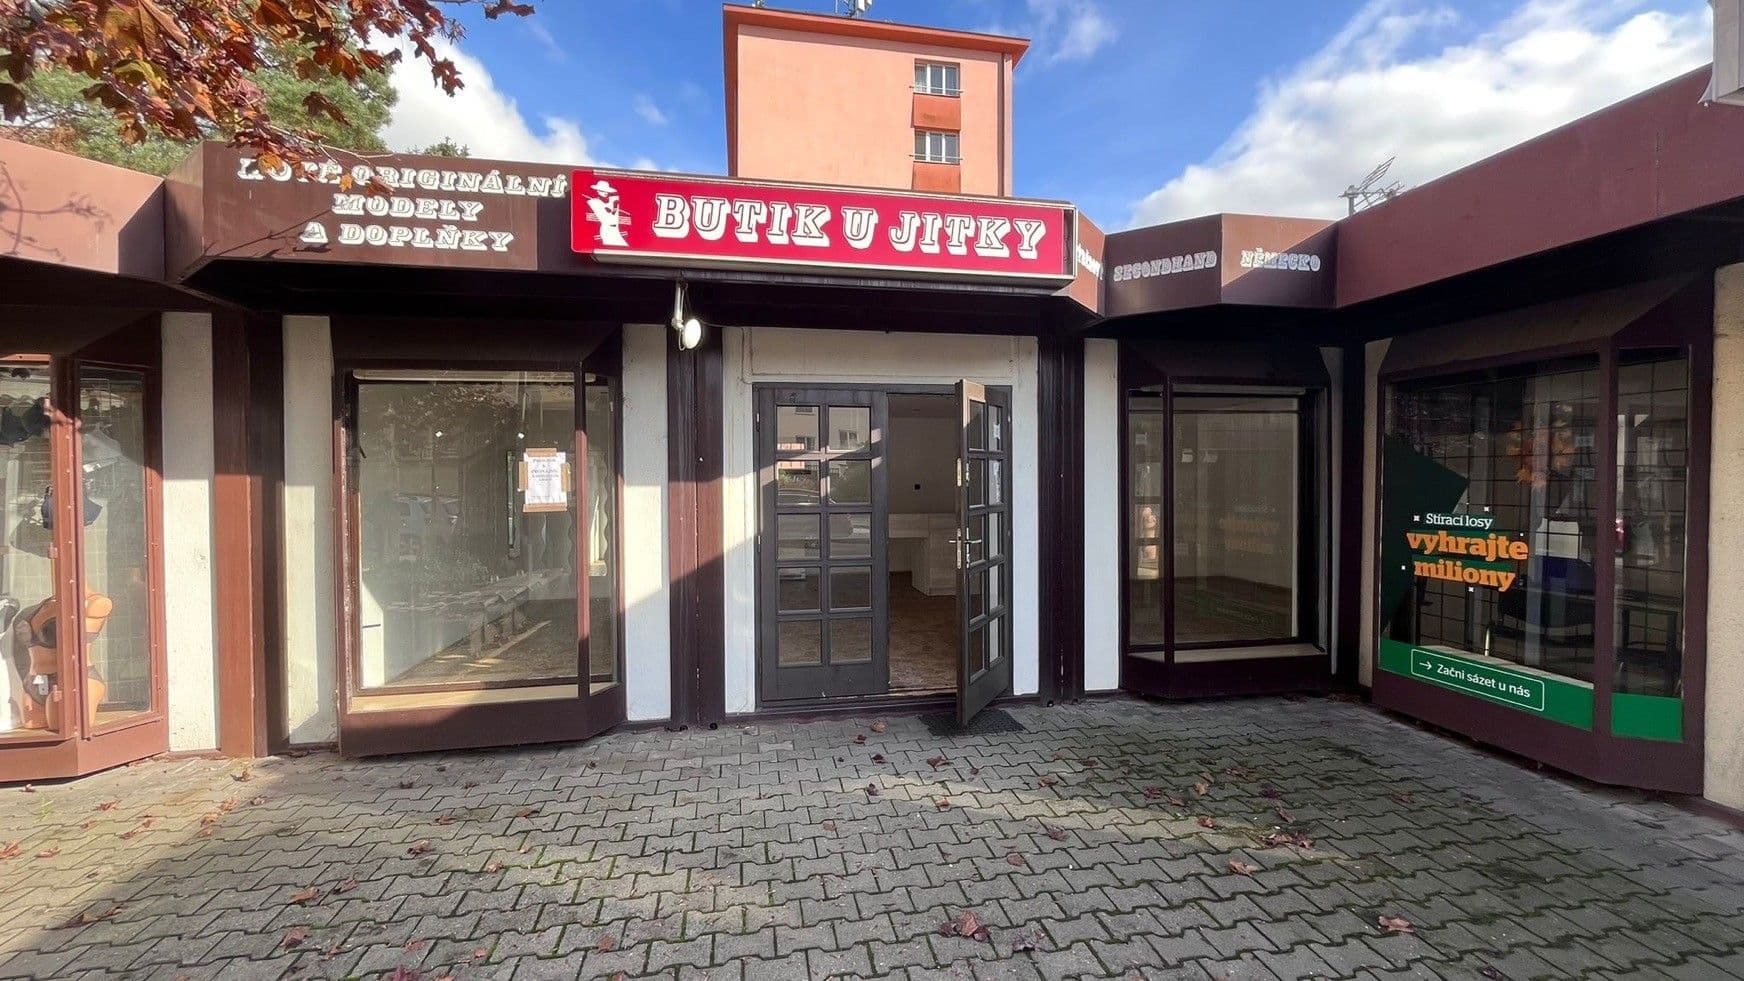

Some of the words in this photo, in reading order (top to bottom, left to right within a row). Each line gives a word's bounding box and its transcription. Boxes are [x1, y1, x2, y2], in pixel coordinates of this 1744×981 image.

[351, 164, 567, 198] ORIGINÁLNÍ
[331, 192, 484, 222] MODELY
[301, 221, 329, 243] A
[338, 222, 514, 251] DOPLŇKY
[652, 194, 830, 247] BUTIK
[841, 208, 878, 250] U
[889, 210, 1046, 260] JITKY
[1114, 250, 1217, 282] SECONDHAND
[1240, 247, 1321, 272] NĚMECKO
[1465, 515, 1493, 530] losy
[1406, 530, 1529, 562] vyhrajte
[1413, 559, 1516, 591] miliony
[1436, 663, 1465, 680] Začni
[1467, 672, 1496, 689] sázet
[1499, 683, 1506, 692] u
[1508, 683, 1531, 698] nás
